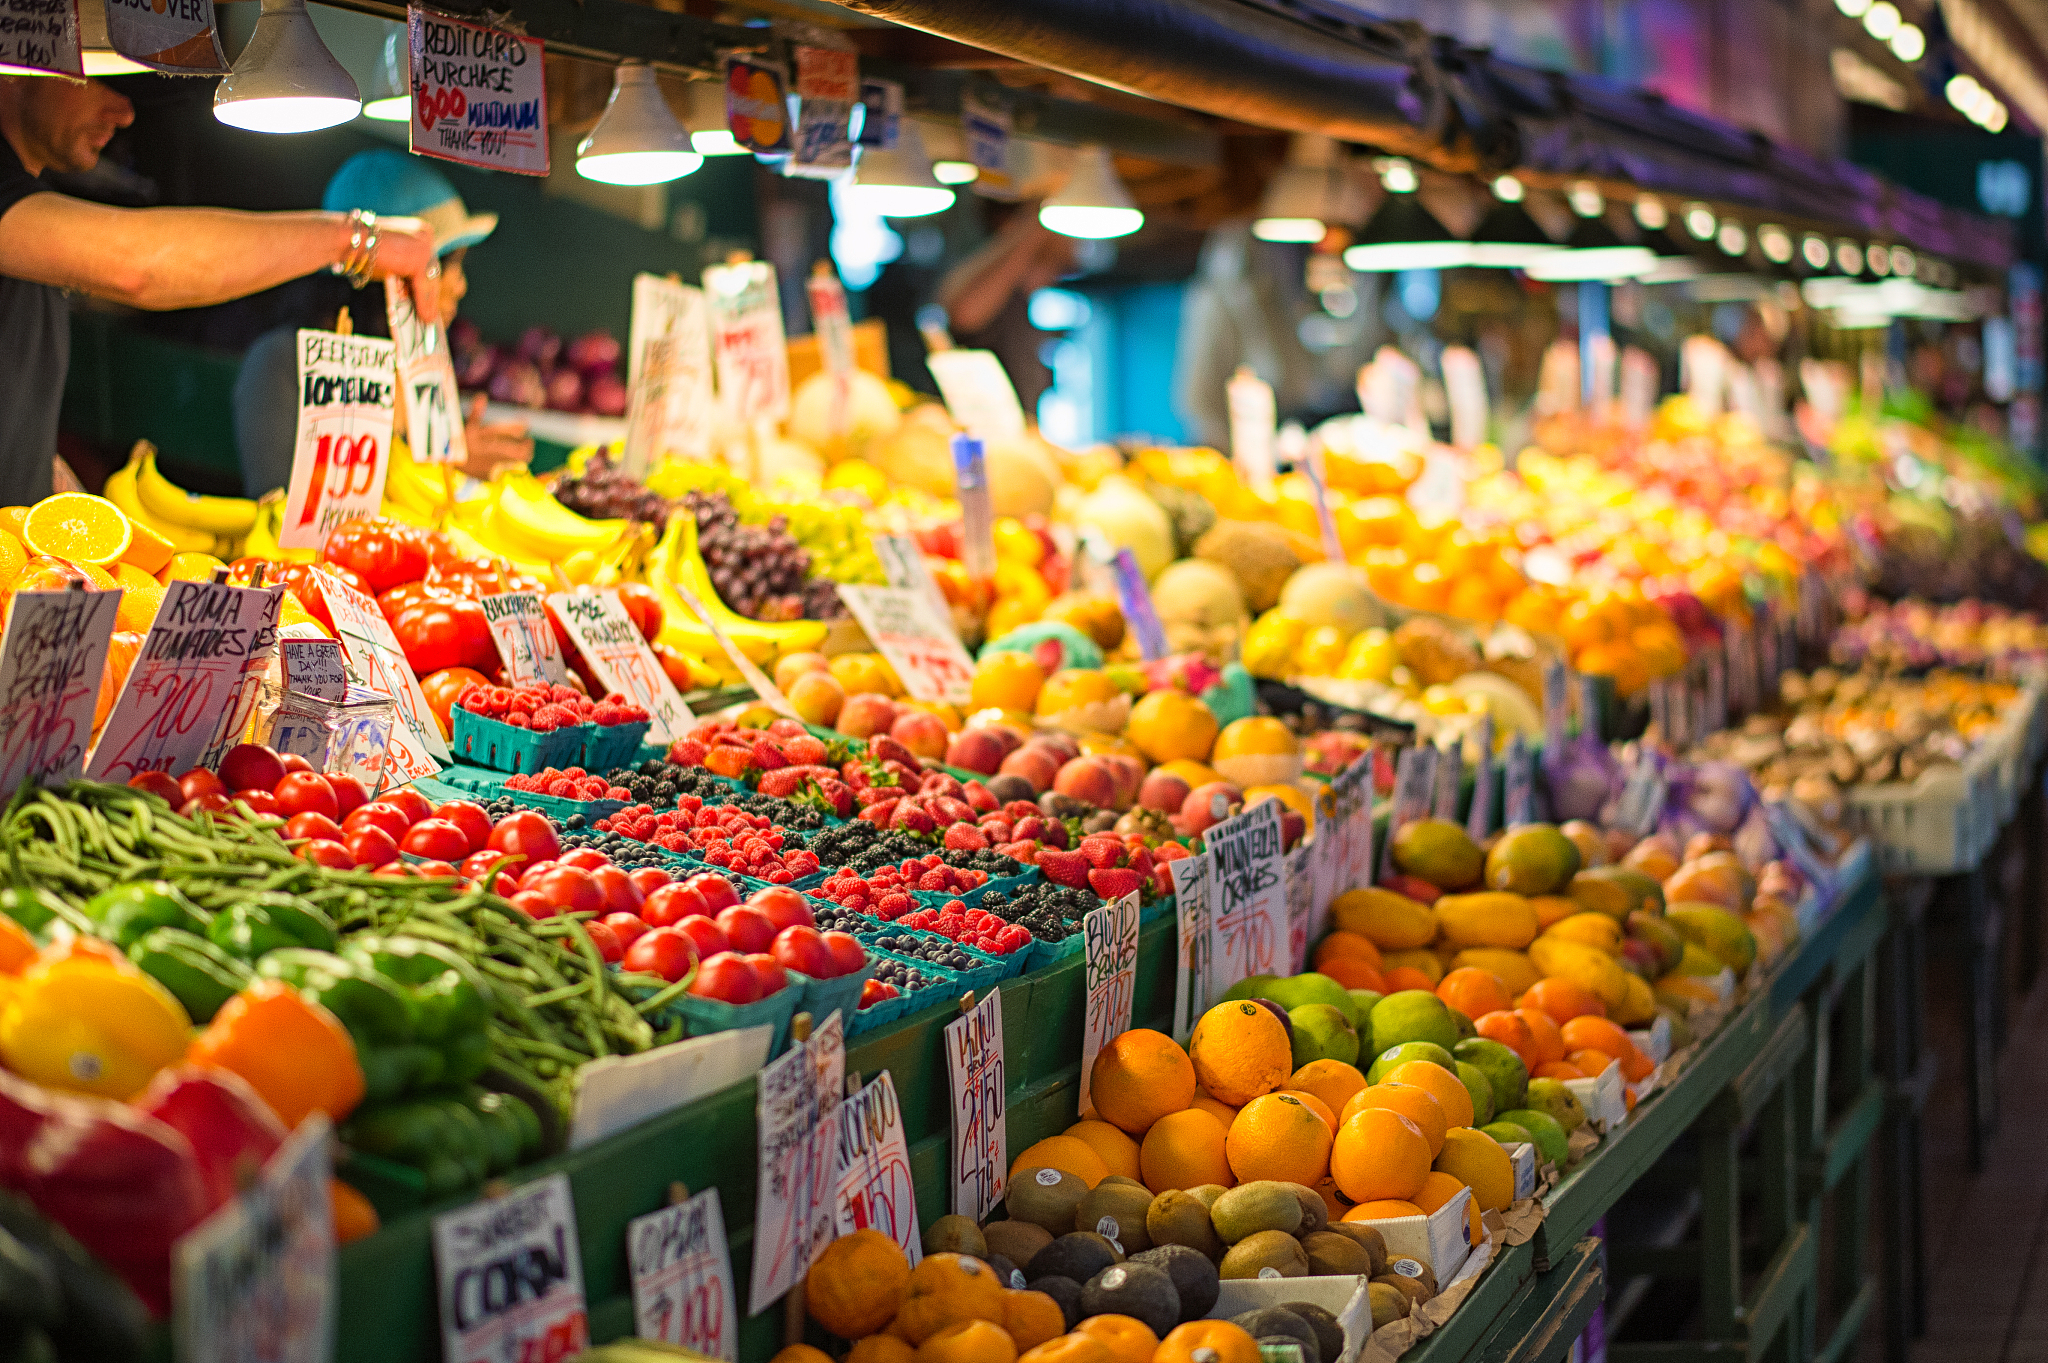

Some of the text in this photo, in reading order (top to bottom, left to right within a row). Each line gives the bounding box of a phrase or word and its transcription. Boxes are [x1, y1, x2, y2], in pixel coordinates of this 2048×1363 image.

[111, 0, 204, 23] SCOVER
[416, 20, 526, 66] REDIT CARD
[422, 56, 513, 94] PURCHASE
[438, 127, 477, 150] THANK
[169, 583, 243, 627] ROMA
[146, 626, 247, 662] TOMATOES
[286, 644, 340, 659] HAVE A GREAT
[289, 673, 344, 686] THANK YOU FOR
[303, 684, 322, 697] YOUR
